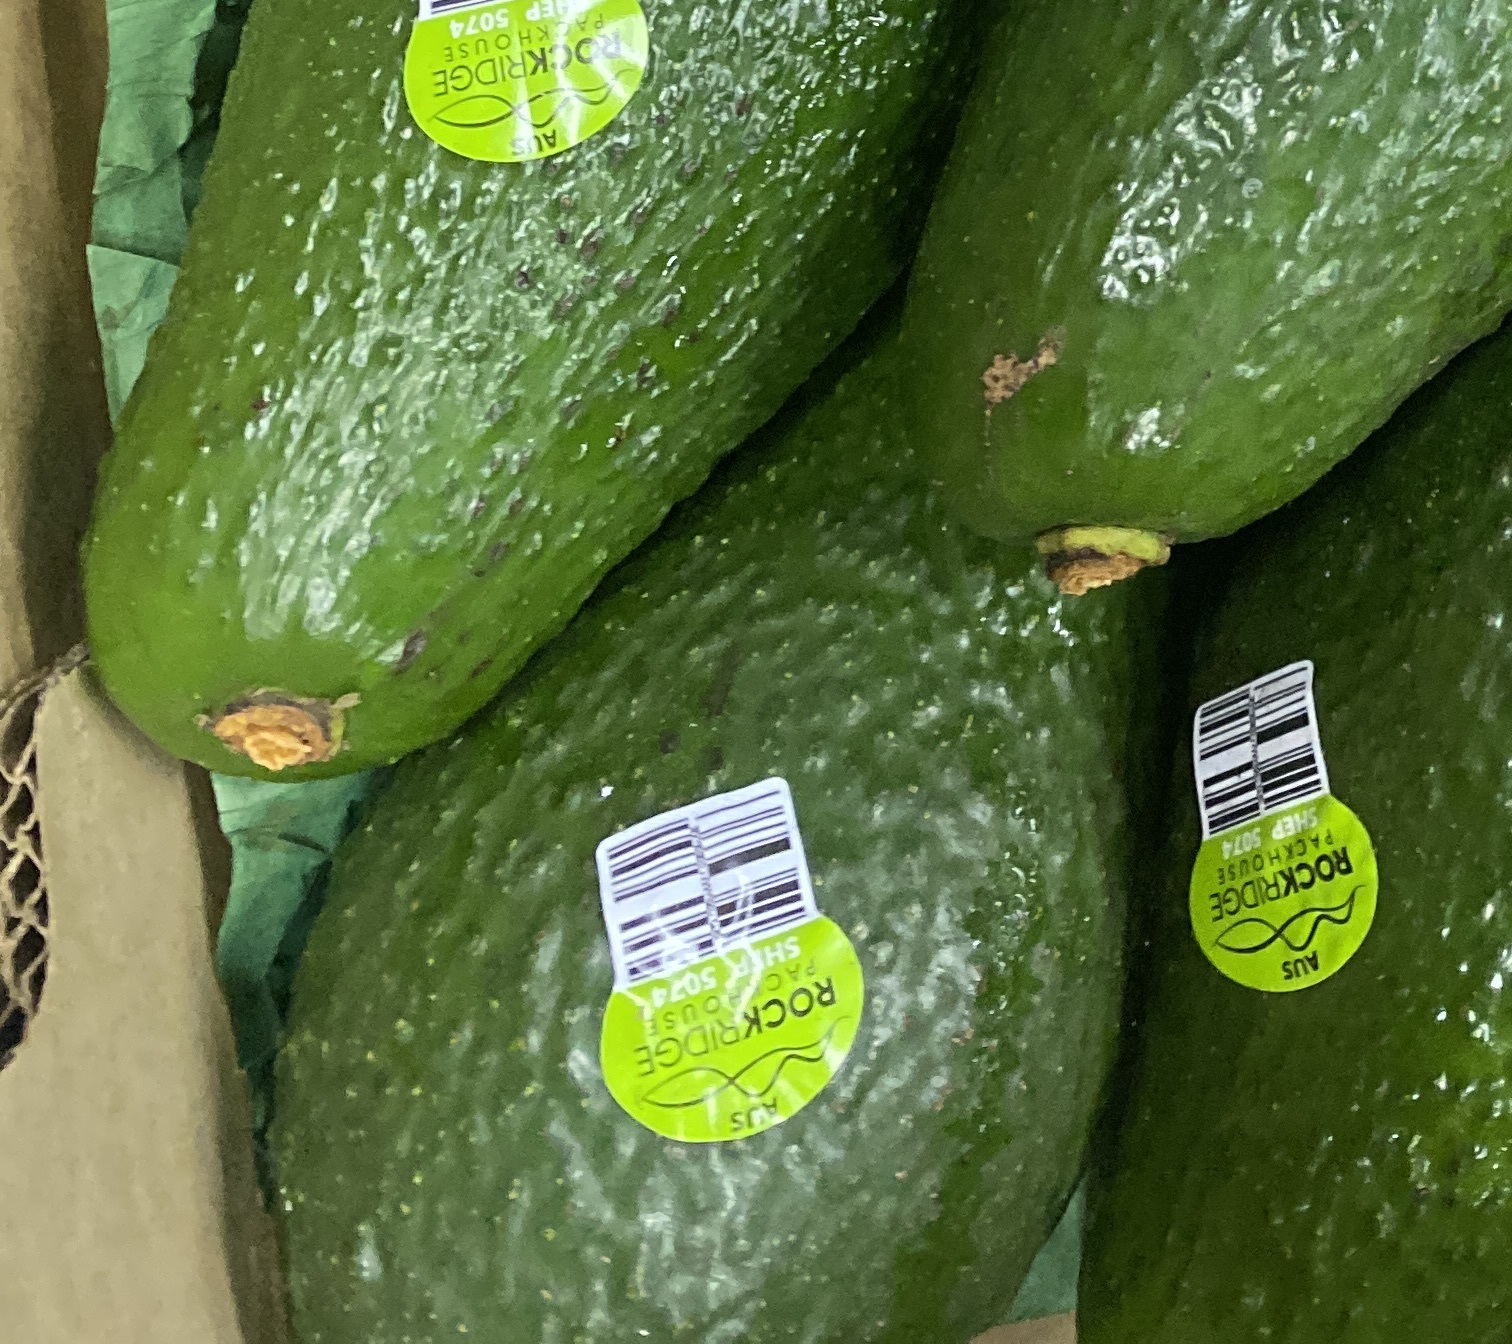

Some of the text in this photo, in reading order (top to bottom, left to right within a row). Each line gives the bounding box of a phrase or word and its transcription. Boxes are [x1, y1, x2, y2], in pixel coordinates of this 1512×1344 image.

[450, 9, 509, 39] 5074
[432, 31, 620, 96] ROCKRIDGE
[1271, 807, 1318, 840] SHEP
[1208, 846, 1354, 922] ROCKRIDGE
[1217, 829, 1333, 885] PACKHOUSE
[651, 966, 716, 1007] 5074
[1282, 951, 1320, 980] AUS
[646, 959, 816, 1035] PACHOUSE
[632, 976, 836, 1076] ROCKRIDGE
